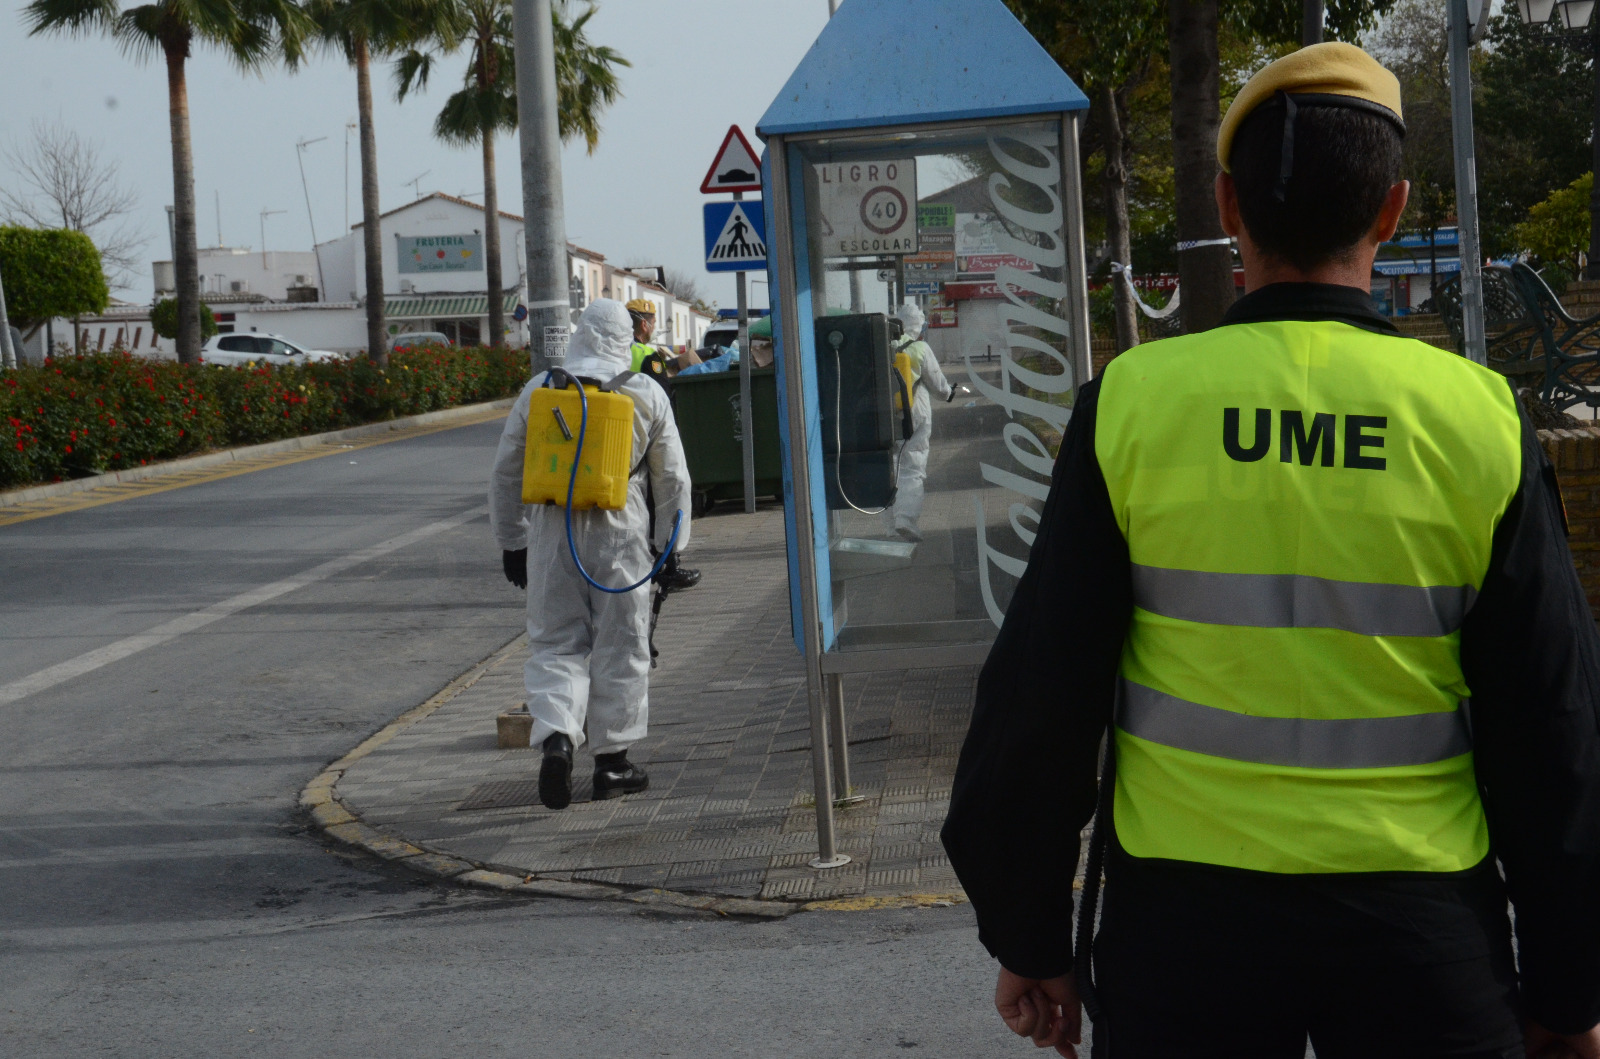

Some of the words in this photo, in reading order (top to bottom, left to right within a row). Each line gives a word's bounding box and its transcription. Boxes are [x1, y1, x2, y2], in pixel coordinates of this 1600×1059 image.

[872, 202, 896, 218] 40
[840, 238, 911, 252] ESCOLAR
[1422, 264, 1457, 274] INERNET
[1223, 407, 1387, 470] UME
